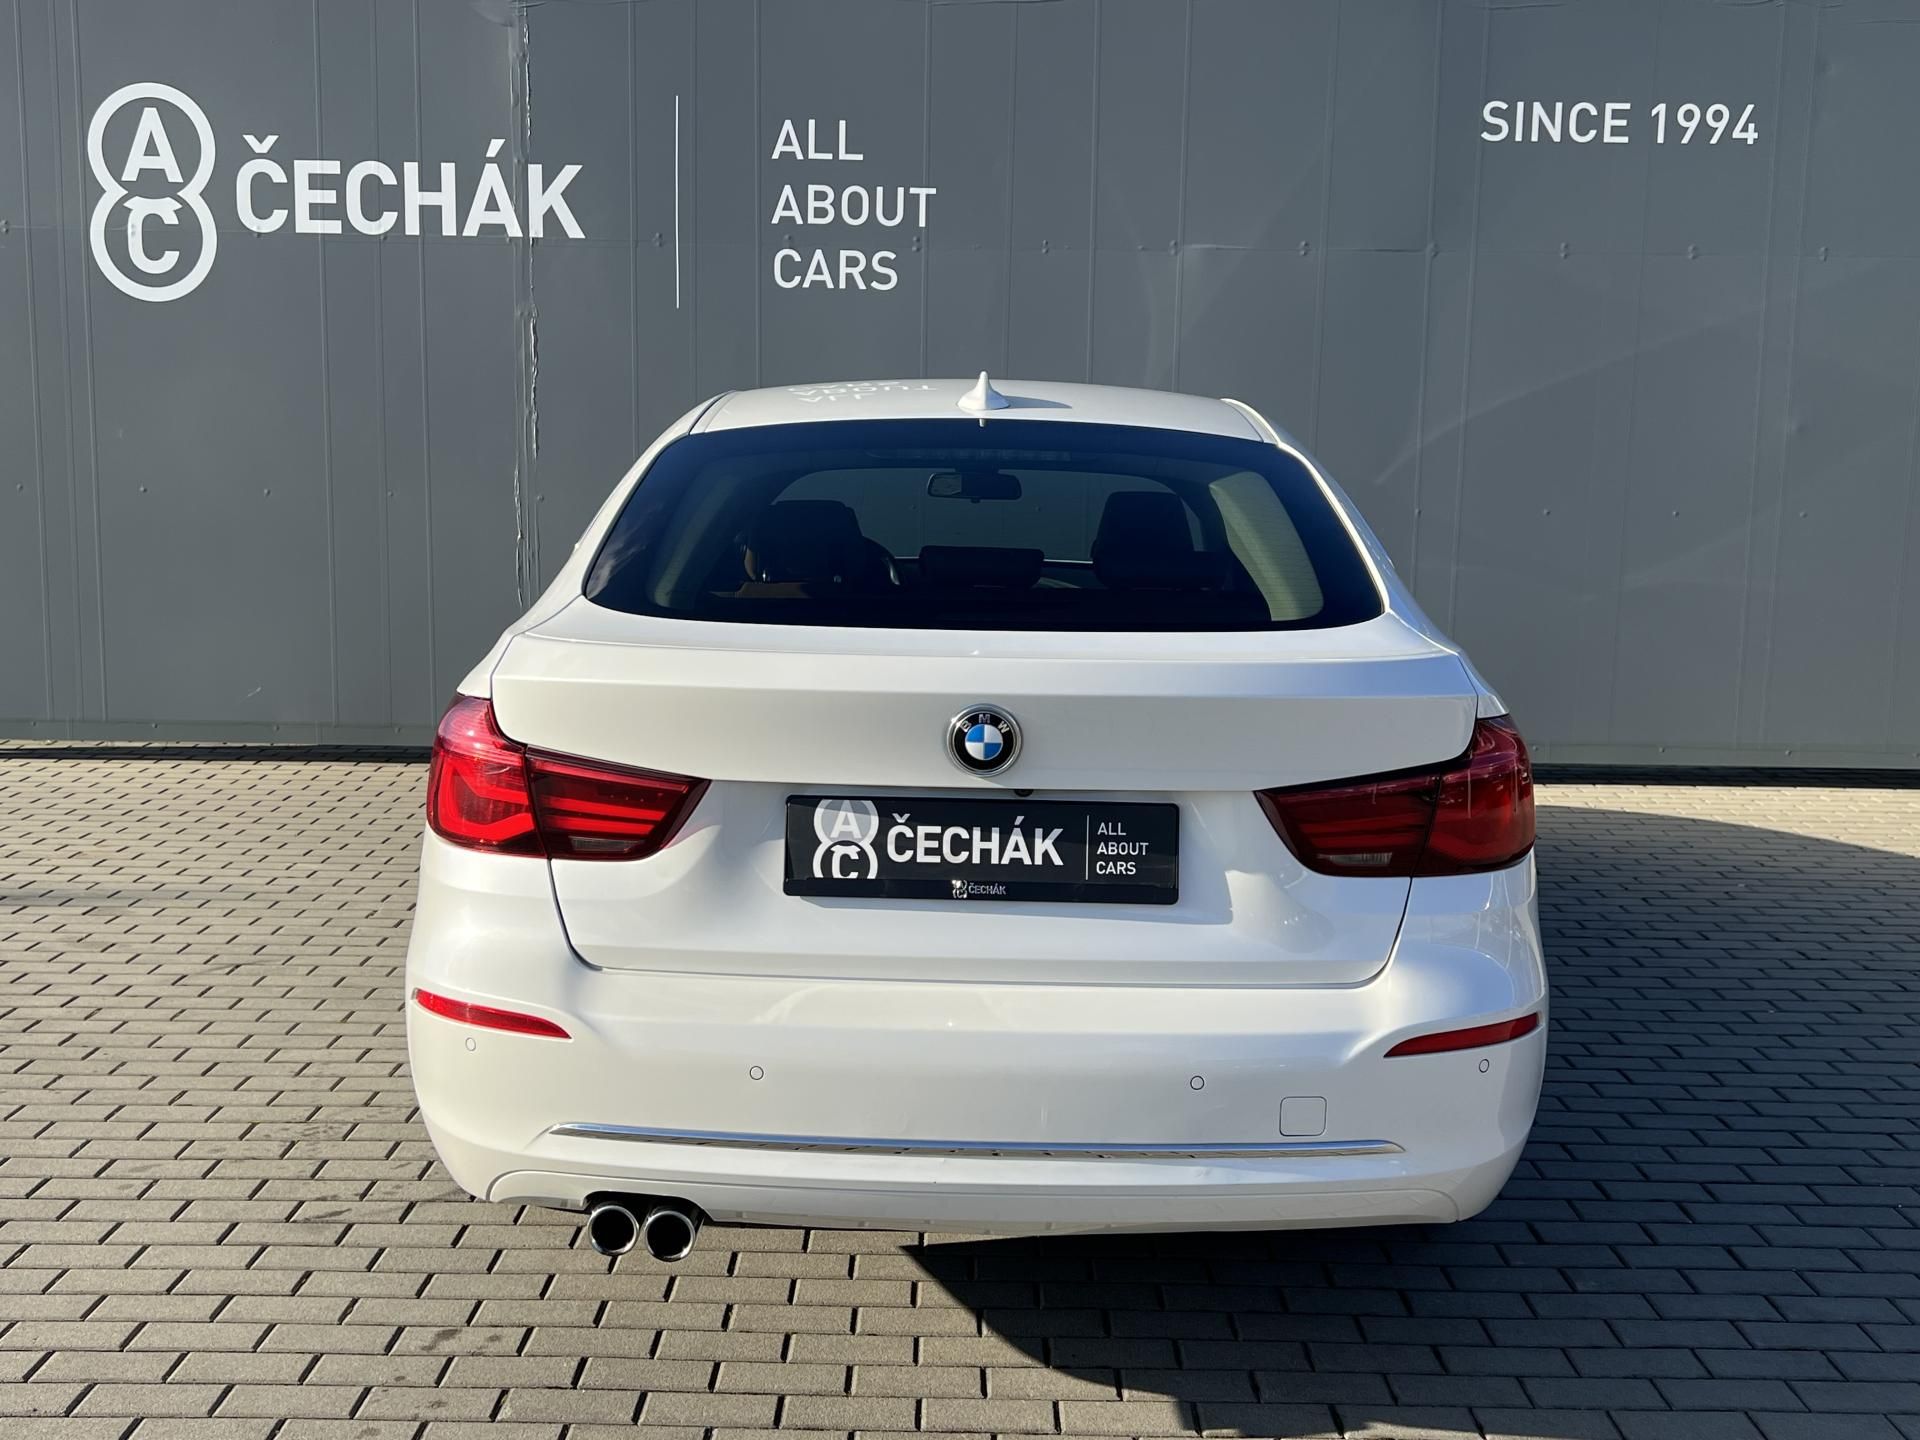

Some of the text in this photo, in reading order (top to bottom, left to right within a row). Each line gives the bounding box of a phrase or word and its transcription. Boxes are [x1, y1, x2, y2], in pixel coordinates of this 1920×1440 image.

[771, 119, 864, 160] ALL
[1480, 100, 1759, 144] SINCE 1994
[236, 134, 586, 239] ČECHÁK
[771, 184, 937, 228] ABOUT
[773, 248, 898, 291] CARS
[959, 713, 1010, 734] BMW
[887, 813, 1064, 866] ČECHÁK
[1097, 822, 1127, 835] ALL
[1097, 842, 1149, 855] ABOUT
[968, 882, 1007, 895] ČECHÁK
[1096, 861, 1137, 875] CARS
